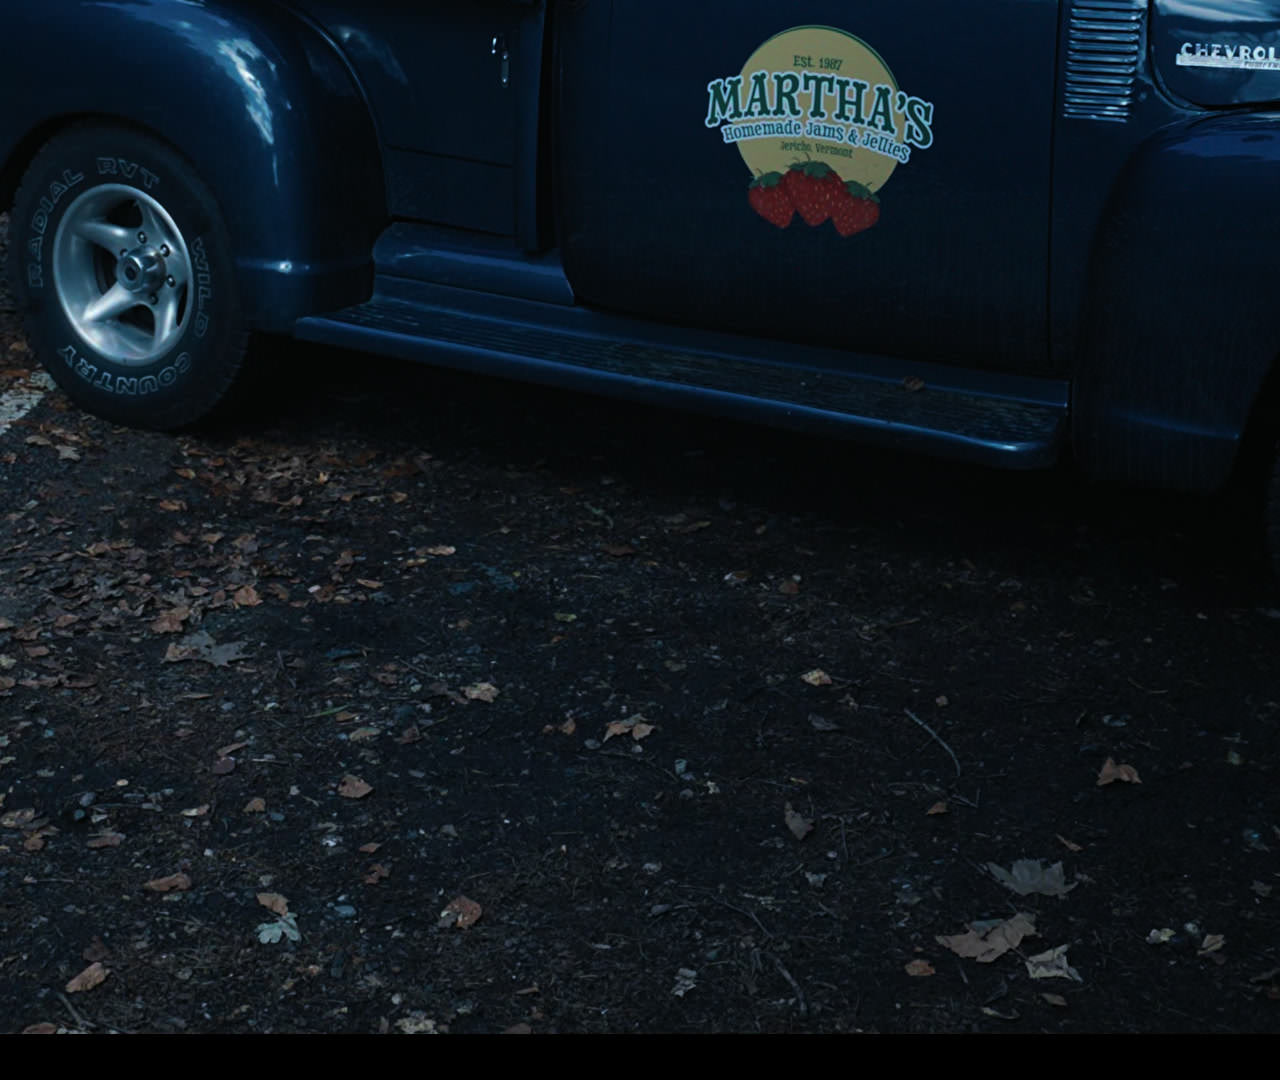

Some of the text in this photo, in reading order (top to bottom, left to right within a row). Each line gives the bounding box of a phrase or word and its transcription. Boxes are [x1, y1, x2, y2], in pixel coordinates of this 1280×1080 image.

[706, 71, 933, 148] MARTHA'S
[723, 119, 910, 161] Homemade Jams & Jellies
[27, 156, 160, 289] RADIAL RVT
[57, 235, 213, 396] WILD COUNTRY
